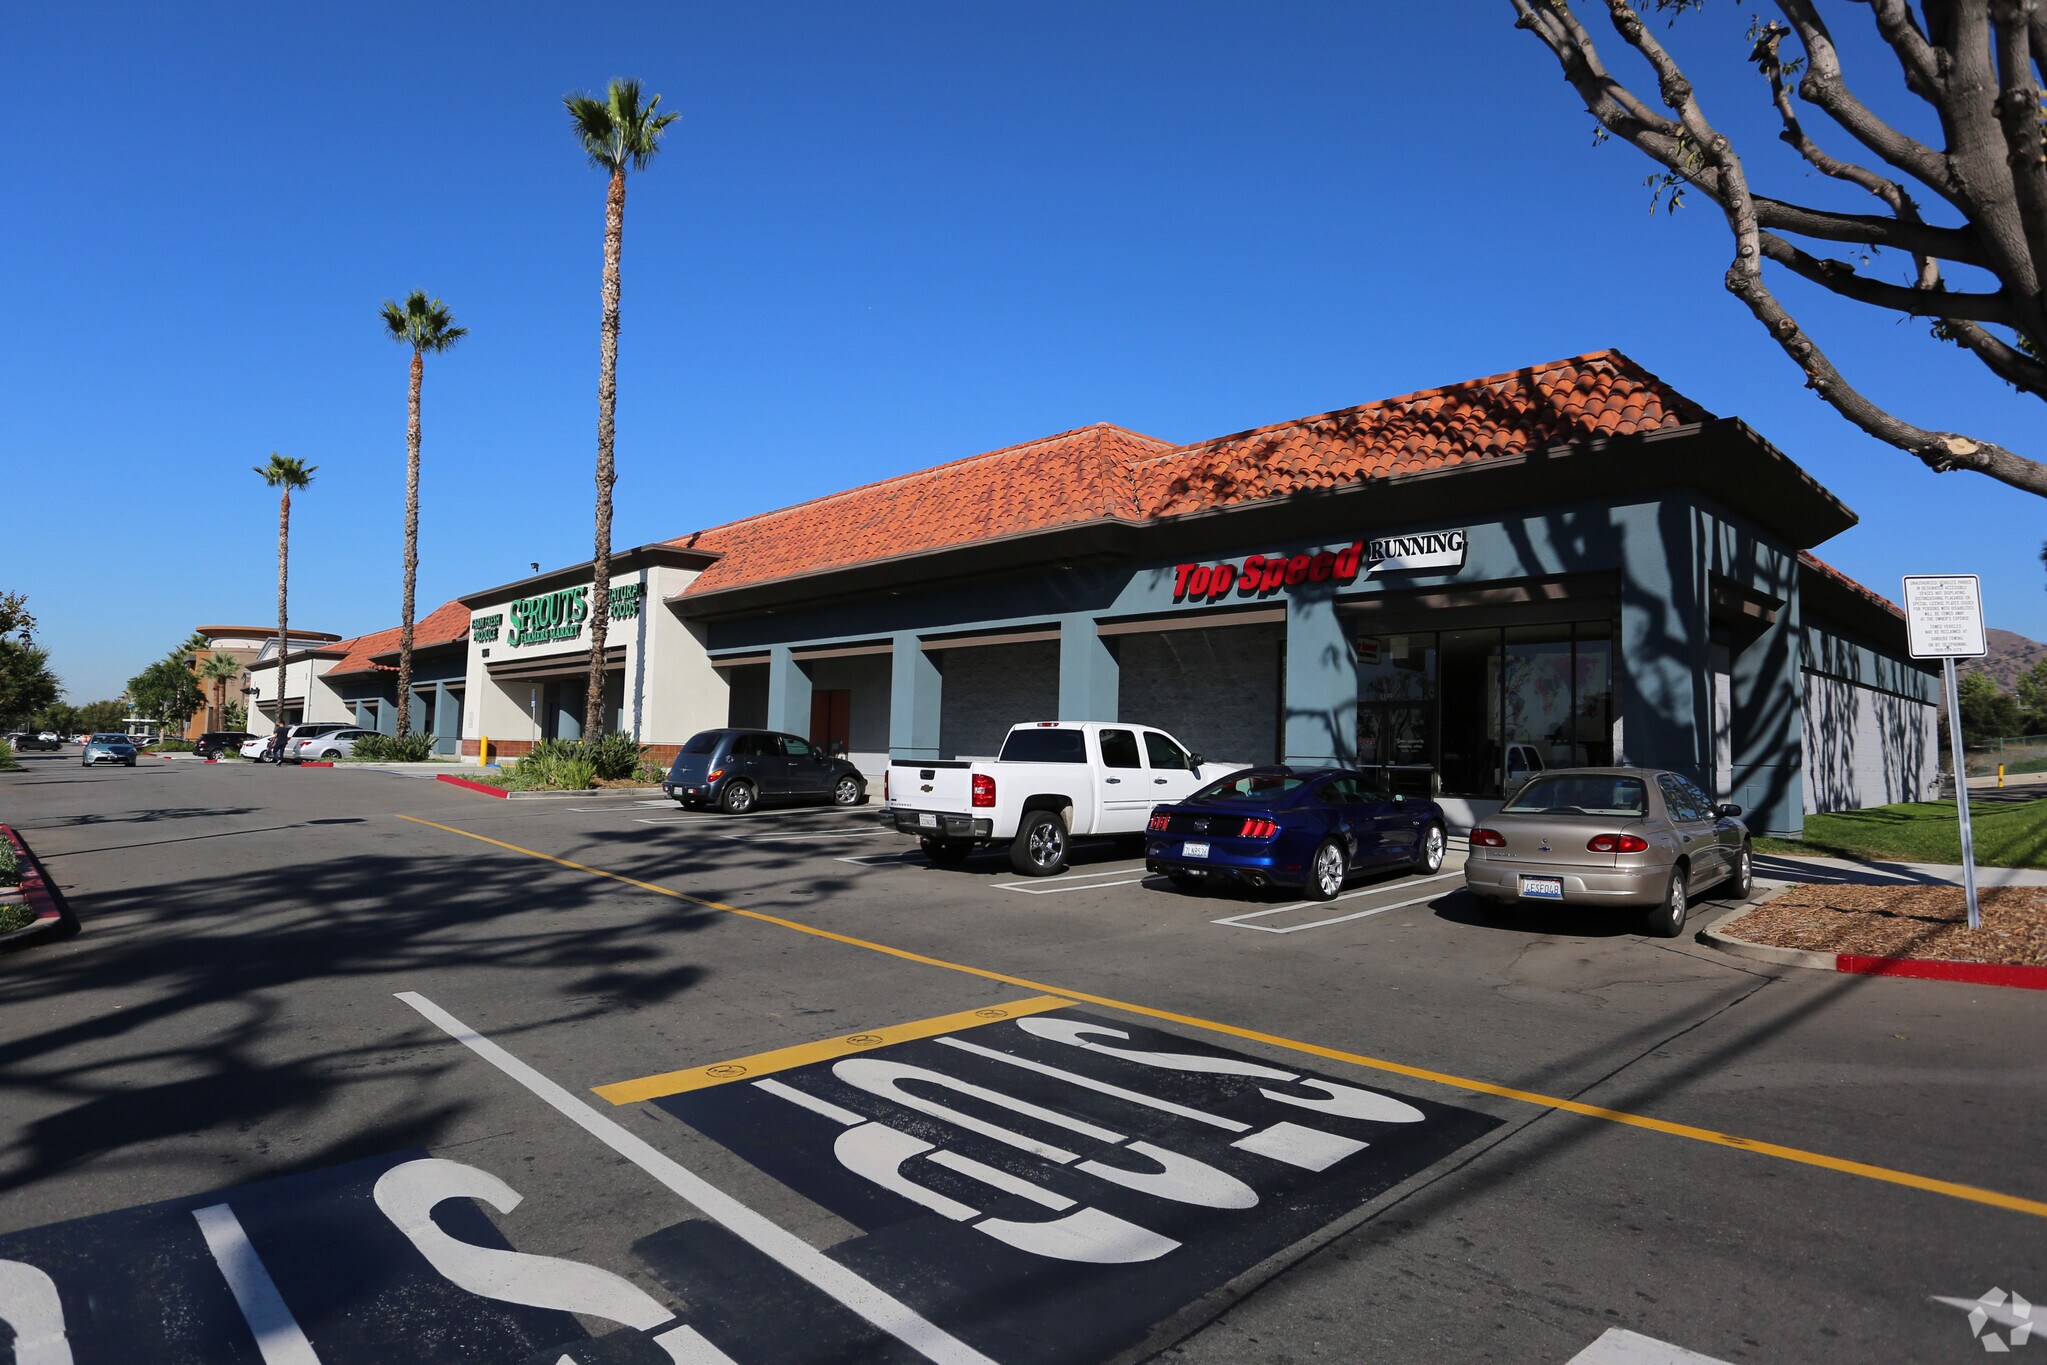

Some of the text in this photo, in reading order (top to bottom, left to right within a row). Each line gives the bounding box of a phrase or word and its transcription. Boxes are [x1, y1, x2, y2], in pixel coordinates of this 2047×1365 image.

[1173, 530, 1465, 597] Top Speed RUNNING
[507, 587, 588, 645] SPROUTS
[520, 624, 580, 643] FARMERS MARKET
[610, 601, 637, 617] FOODS
[751, 1017, 1425, 1264] STOP
